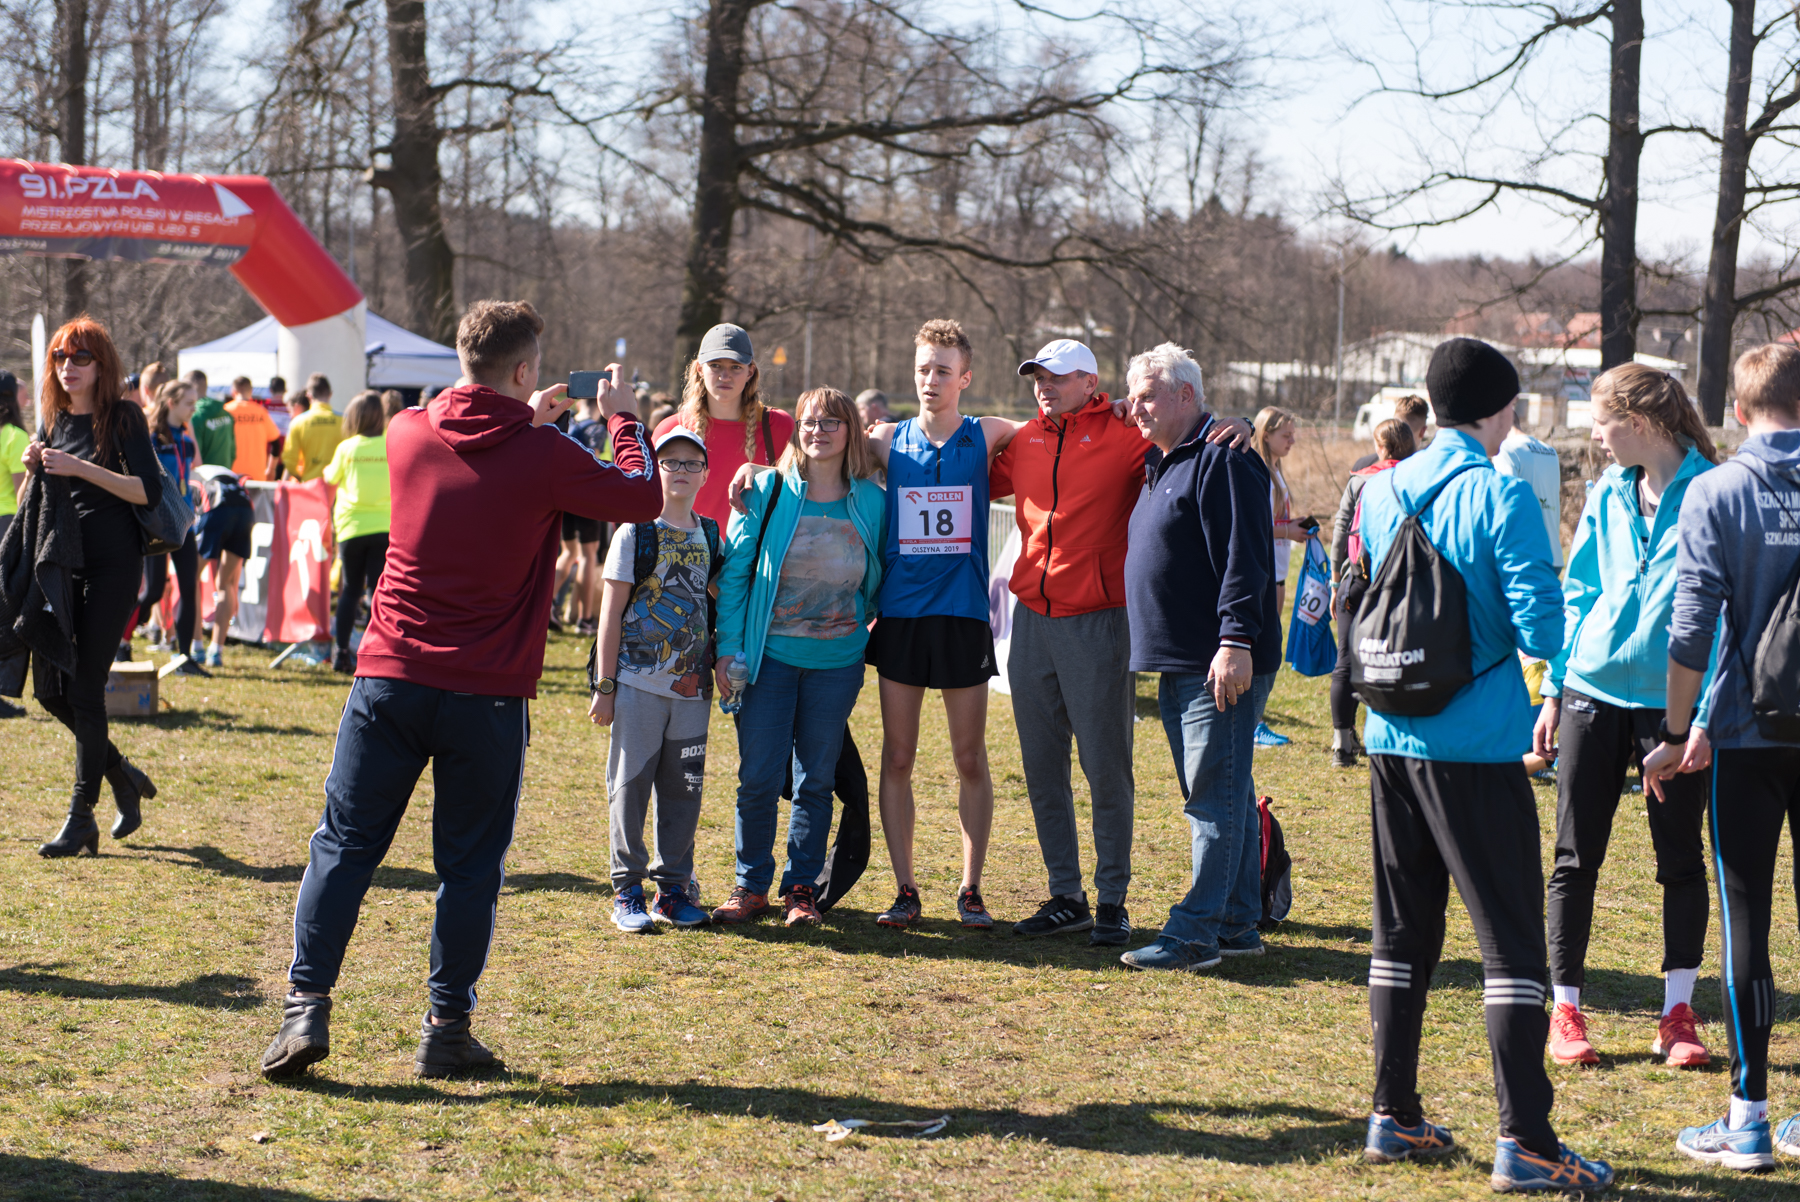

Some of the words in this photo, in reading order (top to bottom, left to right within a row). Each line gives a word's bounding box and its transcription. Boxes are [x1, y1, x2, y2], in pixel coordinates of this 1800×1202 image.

[21, 205, 120, 219] MISTRZOSTWA
[121, 206, 167, 220] POLSKI
[929, 492, 962, 502] ORLEN
[919, 508, 954, 536] 18
[659, 543, 691, 551] IGHTING
[1300, 592, 1321, 612] 60
